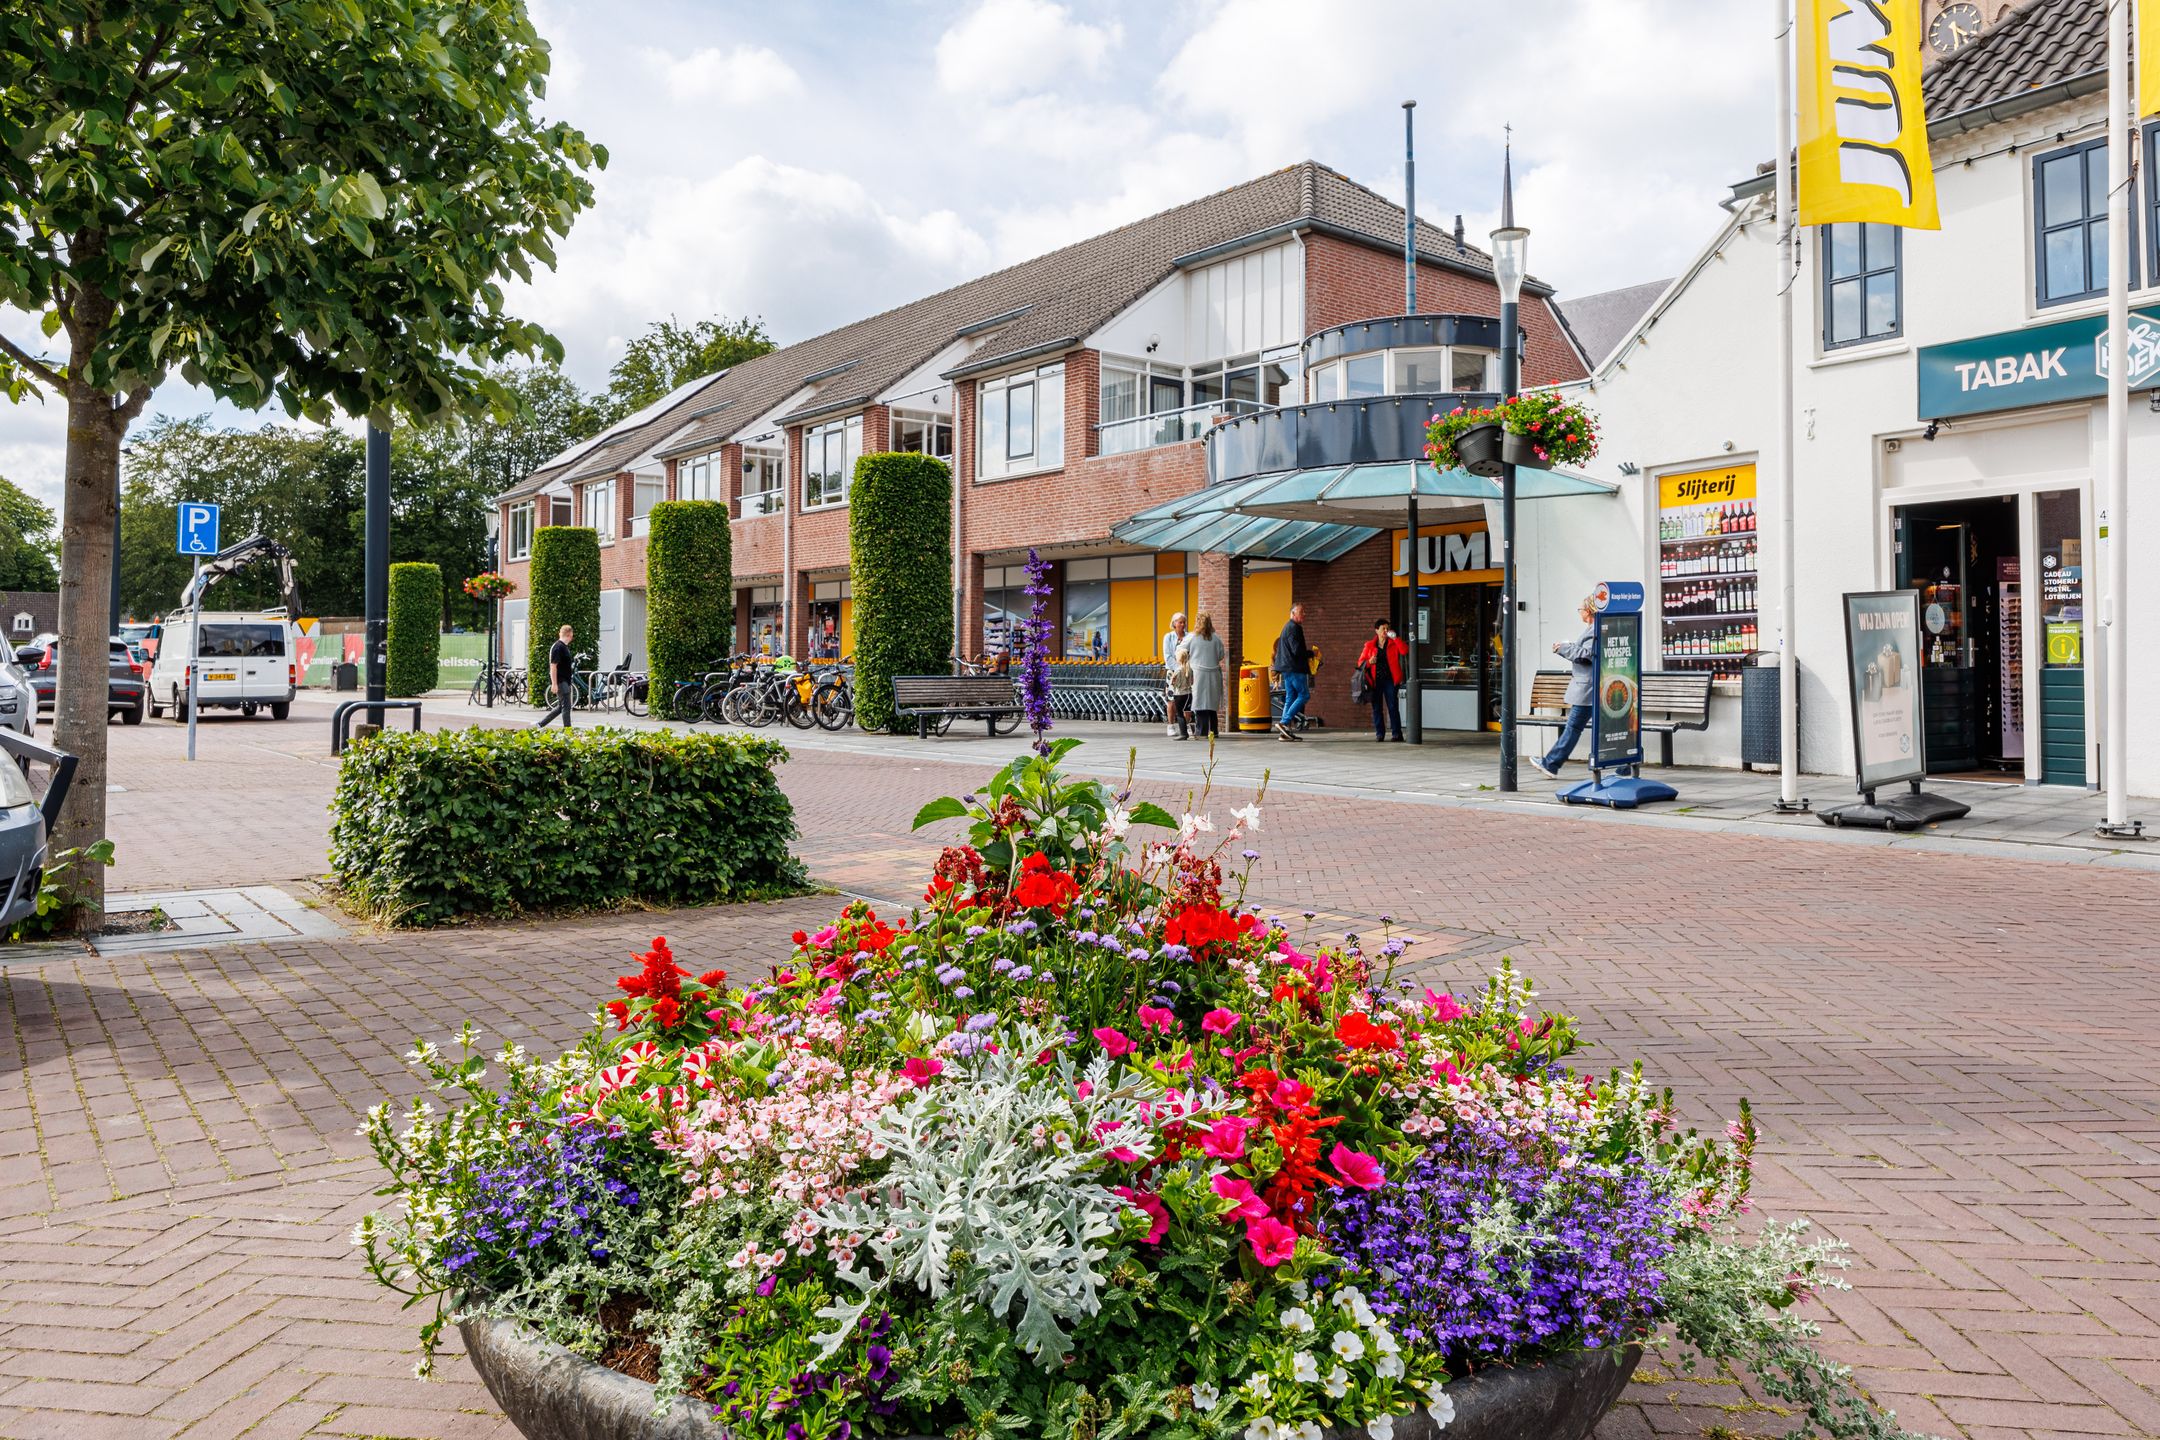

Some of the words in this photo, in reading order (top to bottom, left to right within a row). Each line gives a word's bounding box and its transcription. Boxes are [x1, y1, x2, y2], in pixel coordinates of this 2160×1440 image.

[1827, 0, 1912, 208] JUM
[1954, 346, 2068, 392] TABAK
[1677, 474, 1736, 500] Slijterij
[188, 507, 211, 533] P
[2099, 510, 2107, 520] 4
[1393, 531, 1504, 576] JUM
[2044, 578, 2078, 586] STOMERIJ
[1858, 612, 1874, 631] WIJ
[1874, 612, 1892, 630] ZIJN
[1607, 636, 1618, 648] HET
[1619, 636, 1629, 647] WK
[1603, 646, 1632, 658] VOORSPEL
[1614, 657, 1629, 668] HIER
